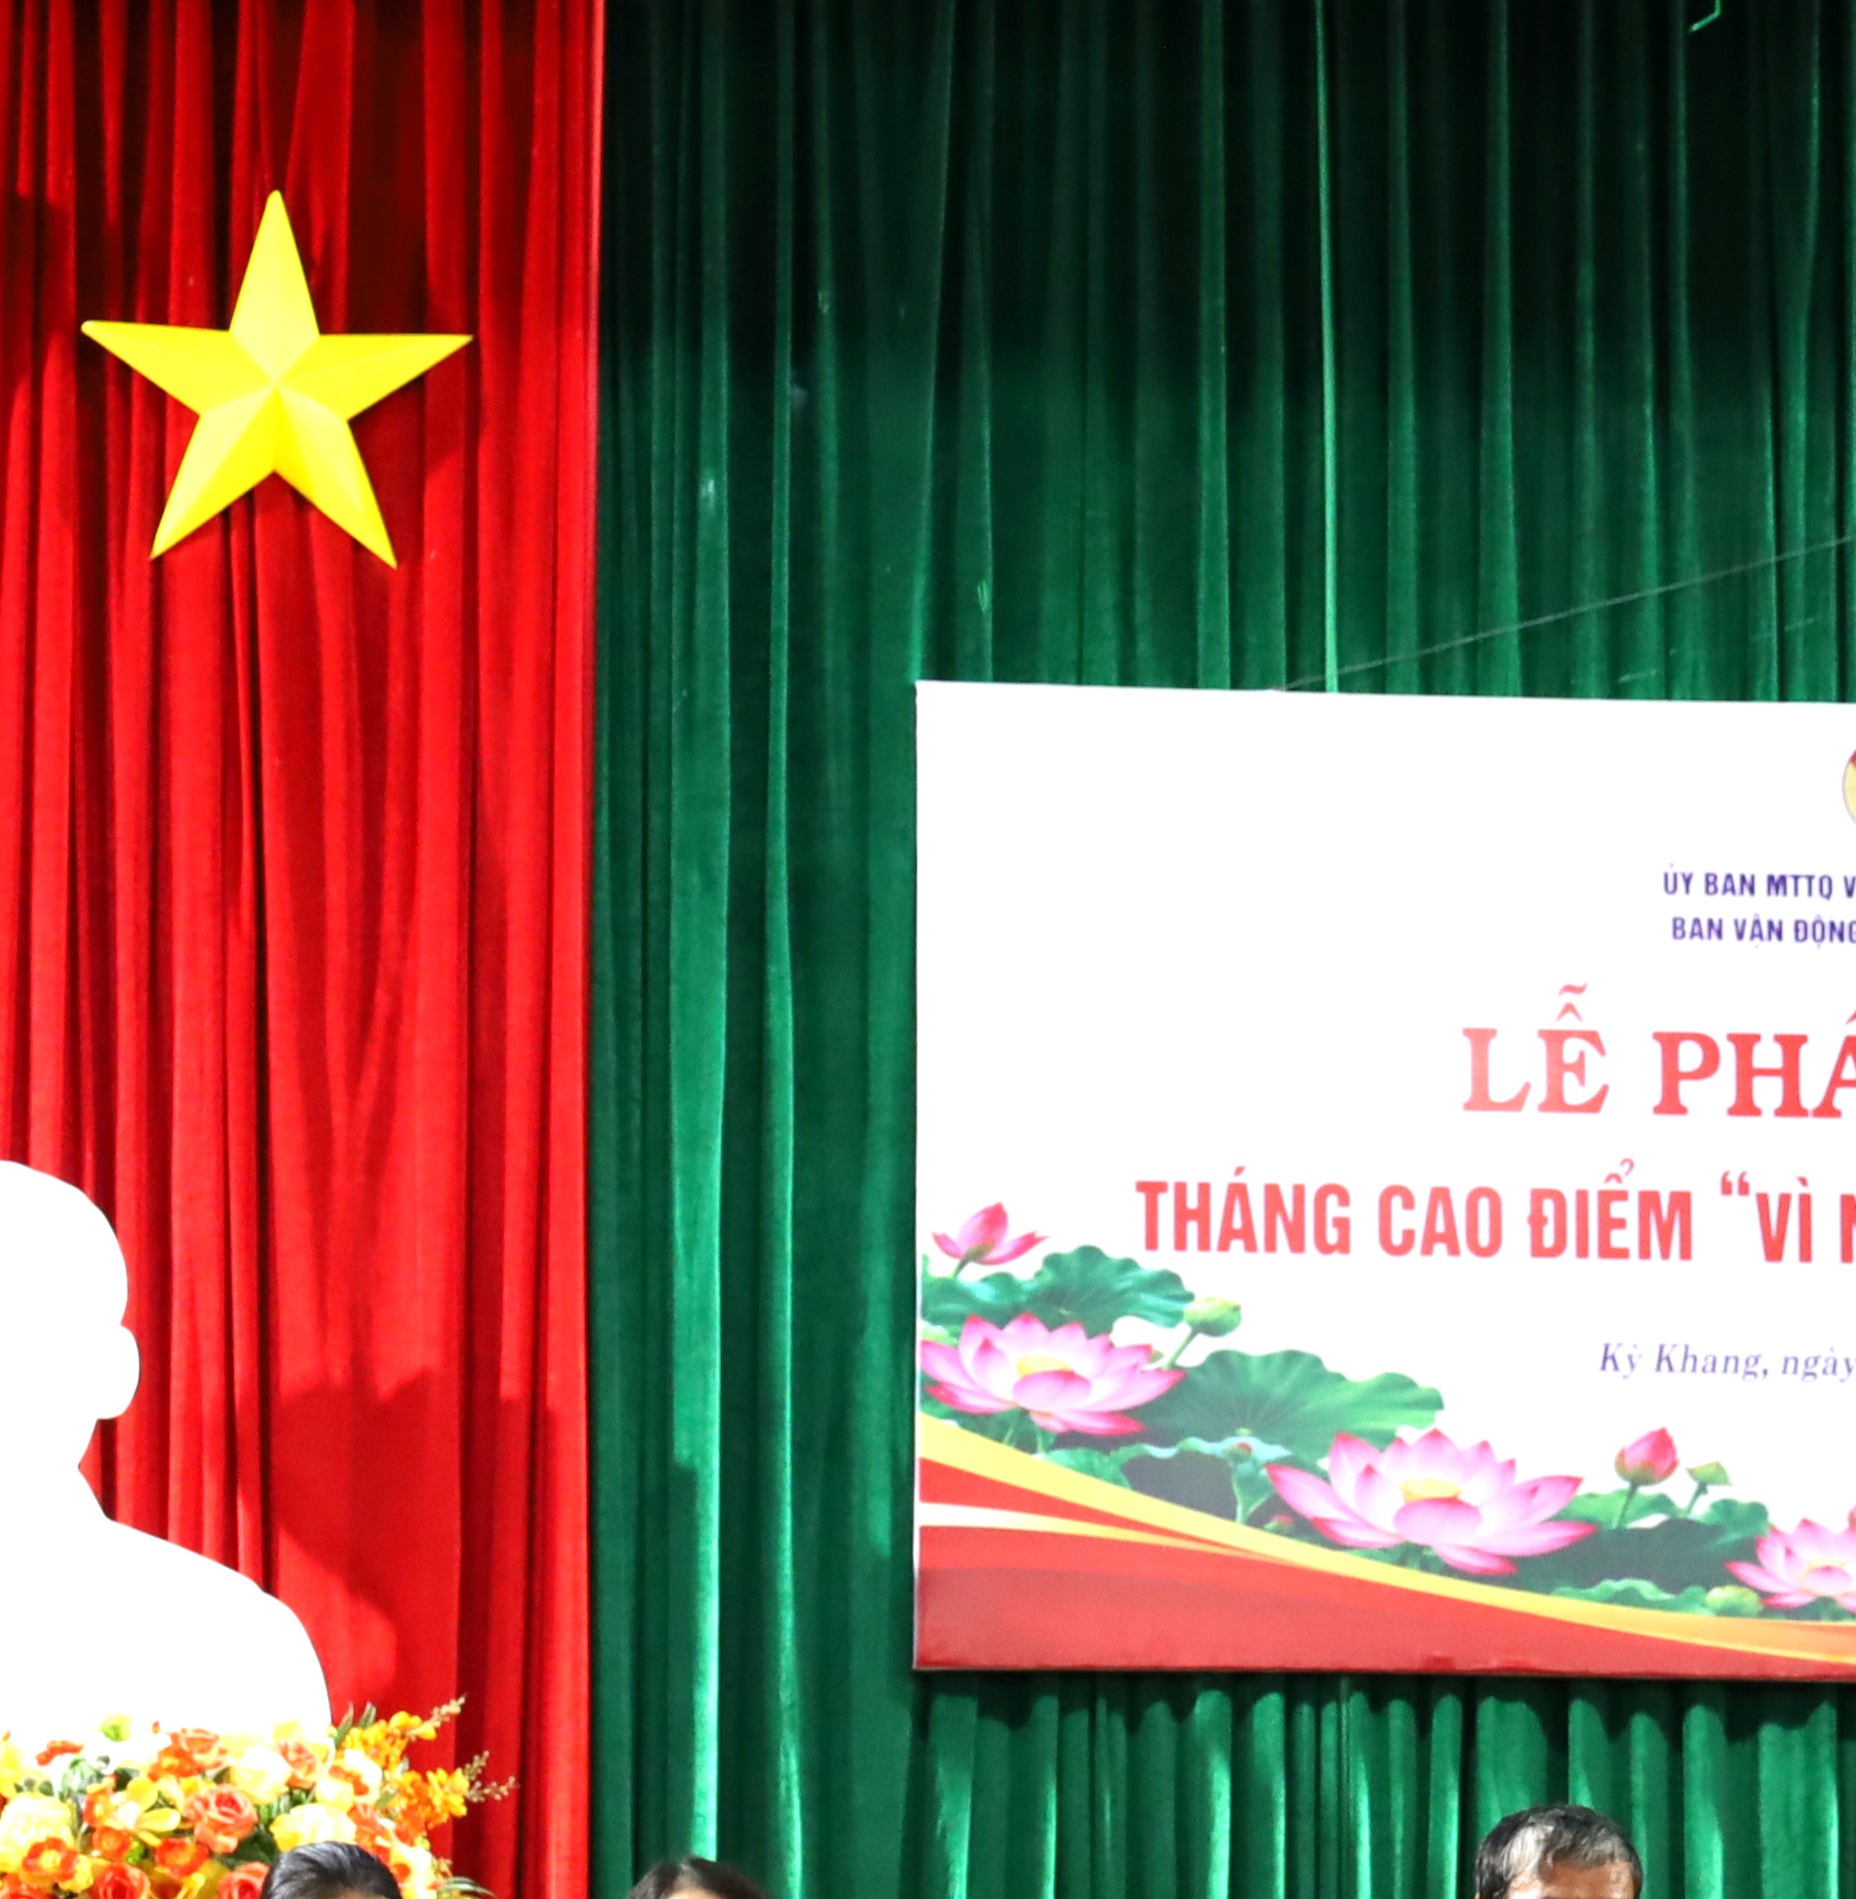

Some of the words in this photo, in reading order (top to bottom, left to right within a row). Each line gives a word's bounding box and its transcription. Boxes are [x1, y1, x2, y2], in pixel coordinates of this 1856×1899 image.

[1704, 872, 1755, 897] BAN
[1766, 874, 1833, 900] MTTQ
[1672, 917, 1723, 941] BAN
[1734, 914, 1783, 947] VẬN
[1464, 985, 1609, 1113] LỄ
[1136, 1166, 1350, 1255] THÁNG
[1379, 1185, 1502, 1258] CAO
[1528, 1159, 1692, 1261] ĐIỂM
[1600, 1343, 1642, 1379] Kỳ
[1655, 1344, 1768, 1382] Khang,
